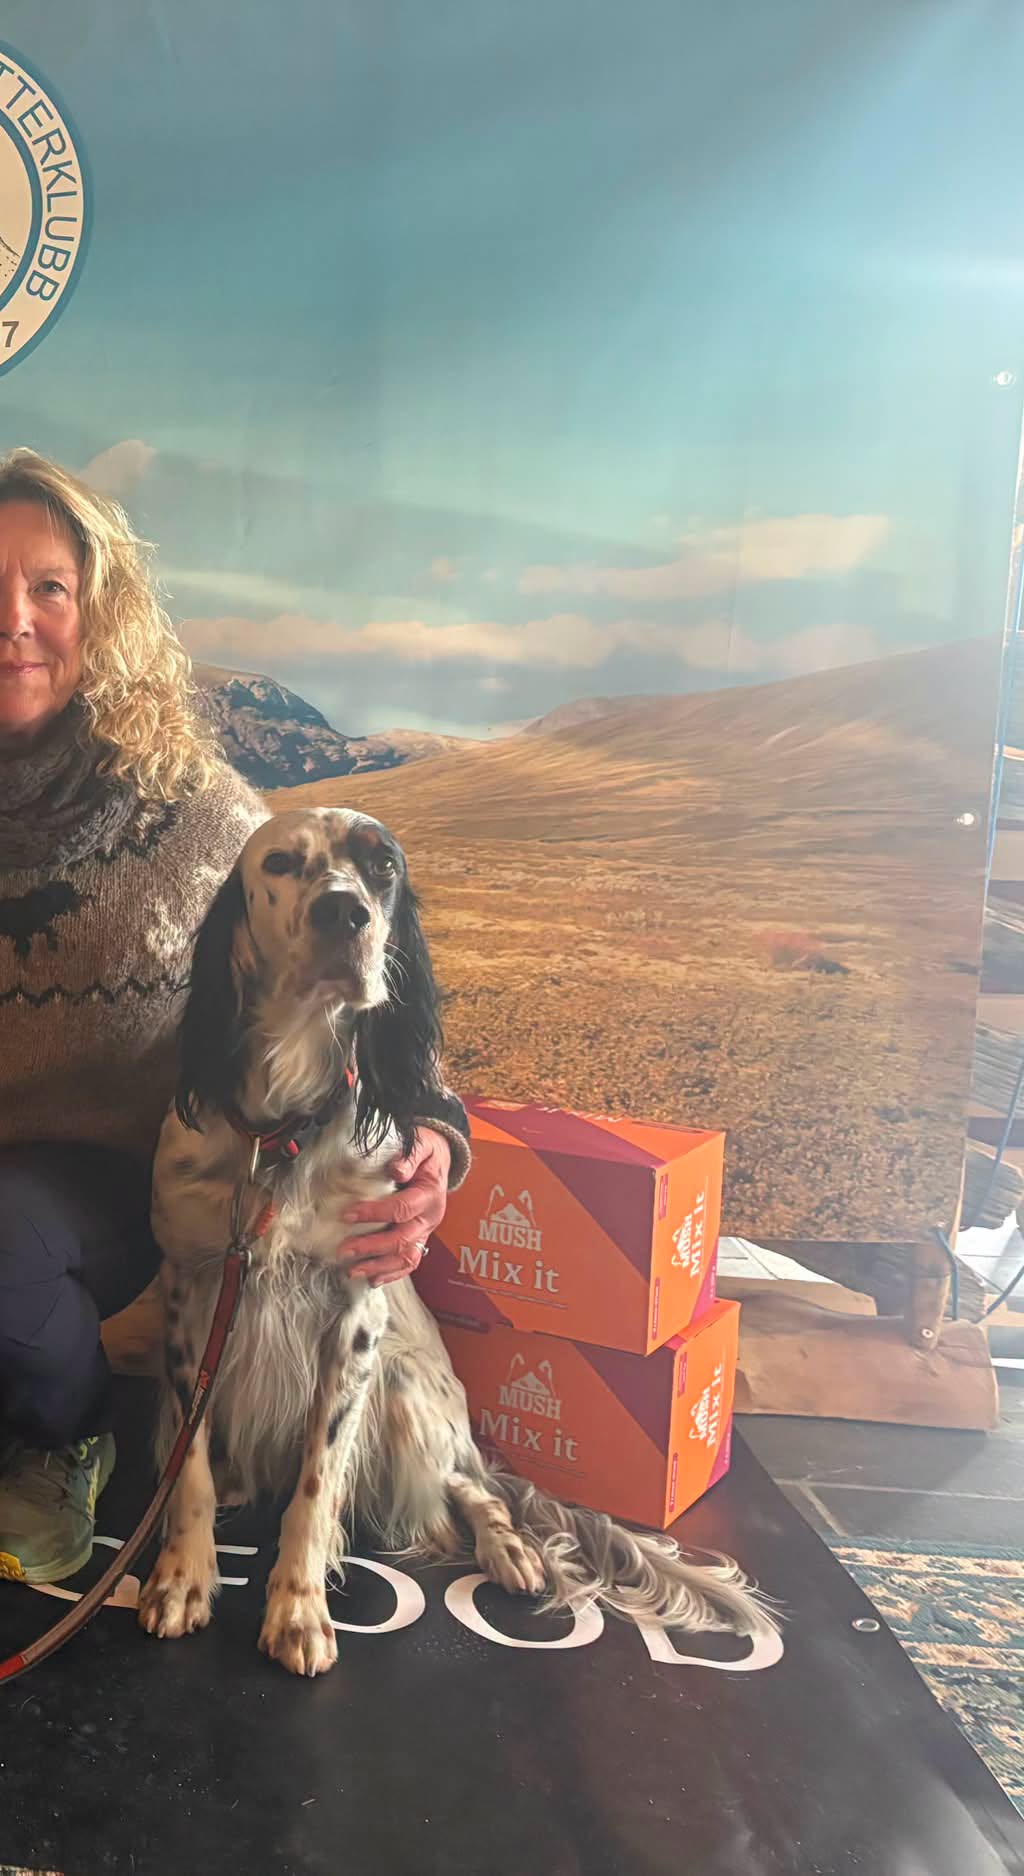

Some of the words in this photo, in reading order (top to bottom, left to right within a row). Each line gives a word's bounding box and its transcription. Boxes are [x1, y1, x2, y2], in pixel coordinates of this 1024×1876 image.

[478, 1219, 542, 1251] MUSH
[690, 1221, 704, 1278] Mix
[457, 1245, 523, 1285] Mix
[534, 1260, 560, 1293] it
[499, 1385, 561, 1420] MUSH
[479, 1408, 542, 1451] Mix
[553, 1427, 579, 1461] it
